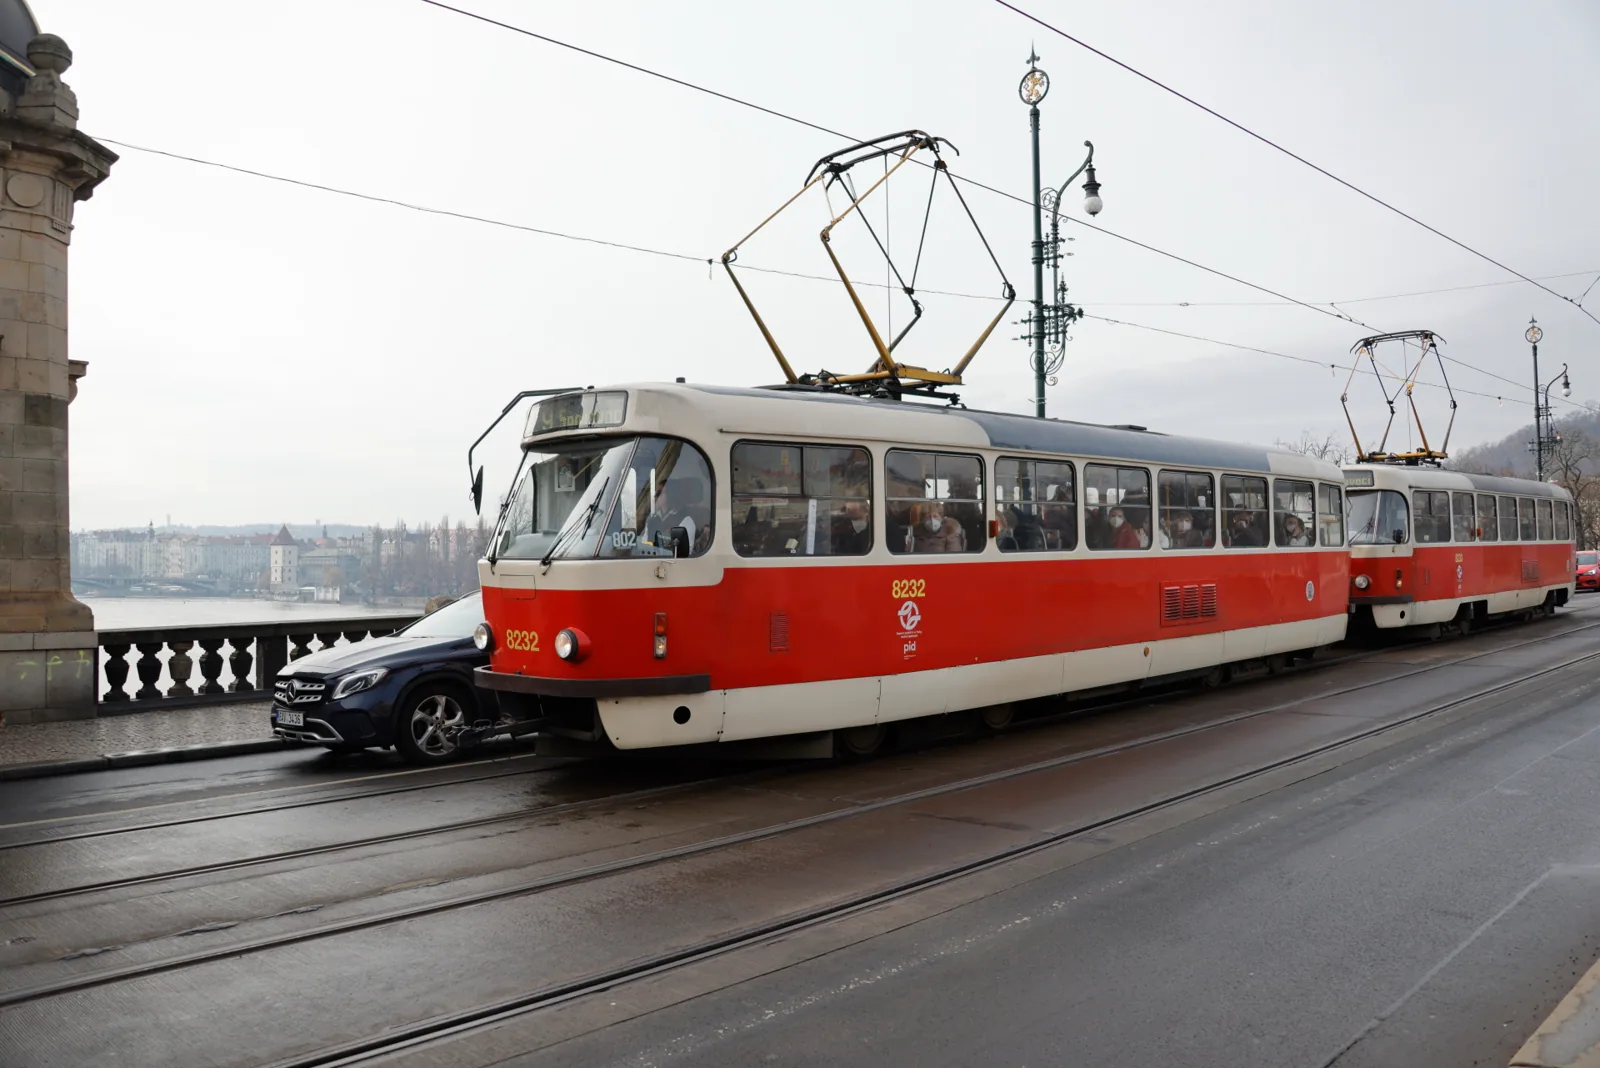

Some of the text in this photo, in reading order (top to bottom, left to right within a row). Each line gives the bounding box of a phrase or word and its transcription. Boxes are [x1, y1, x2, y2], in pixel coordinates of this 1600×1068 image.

[612, 531, 637, 548] 802
[892, 579, 926, 599] 8232
[506, 629, 540, 652] 8232
[903, 640, 917, 654] pid
